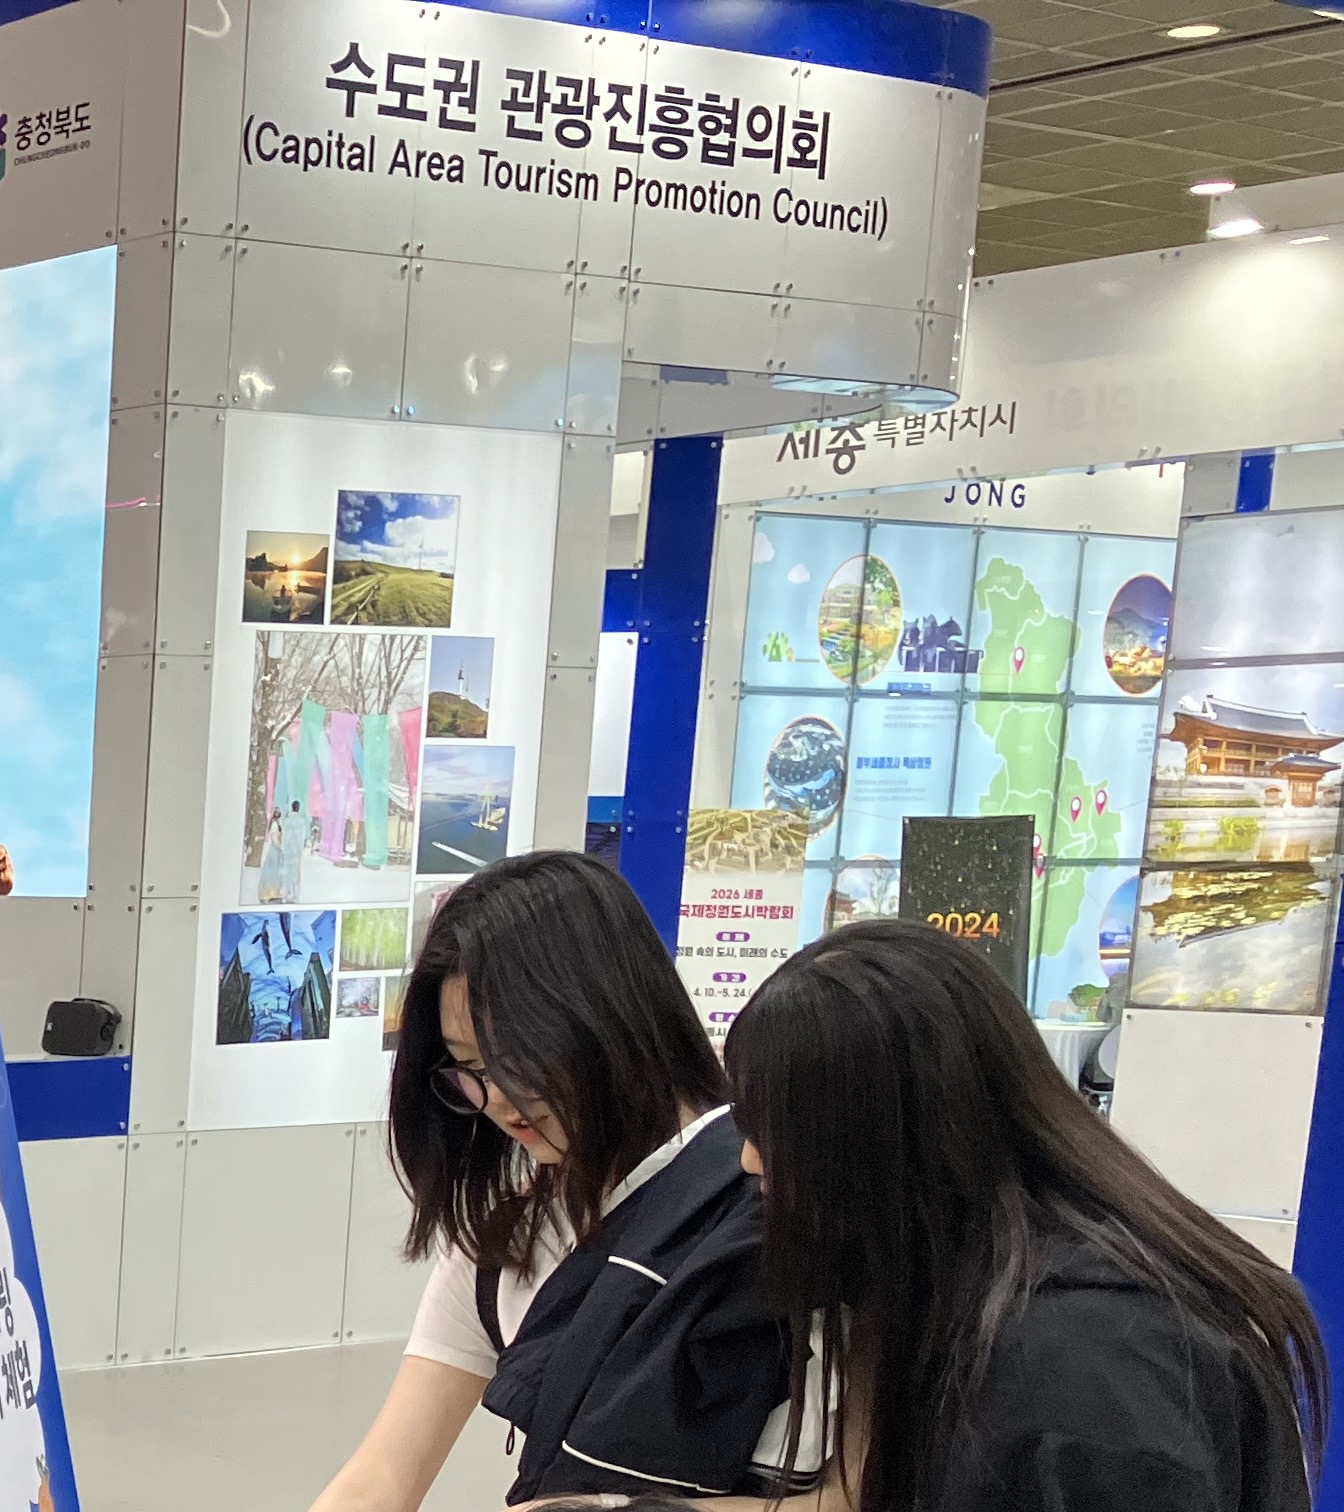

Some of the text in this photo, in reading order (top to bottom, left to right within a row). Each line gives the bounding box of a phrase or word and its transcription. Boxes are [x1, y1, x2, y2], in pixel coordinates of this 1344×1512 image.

[14, 102, 92, 151] 충청북도
[325, 41, 832, 179] 수도권 관광진흥협의회
[243, 113, 888, 241] (Capital Area Tourism Promotion Council)
[711, 889, 740, 900] 2026
[927, 912, 1001, 938] 2024
[2, 1340, 35, 1409] 체험
